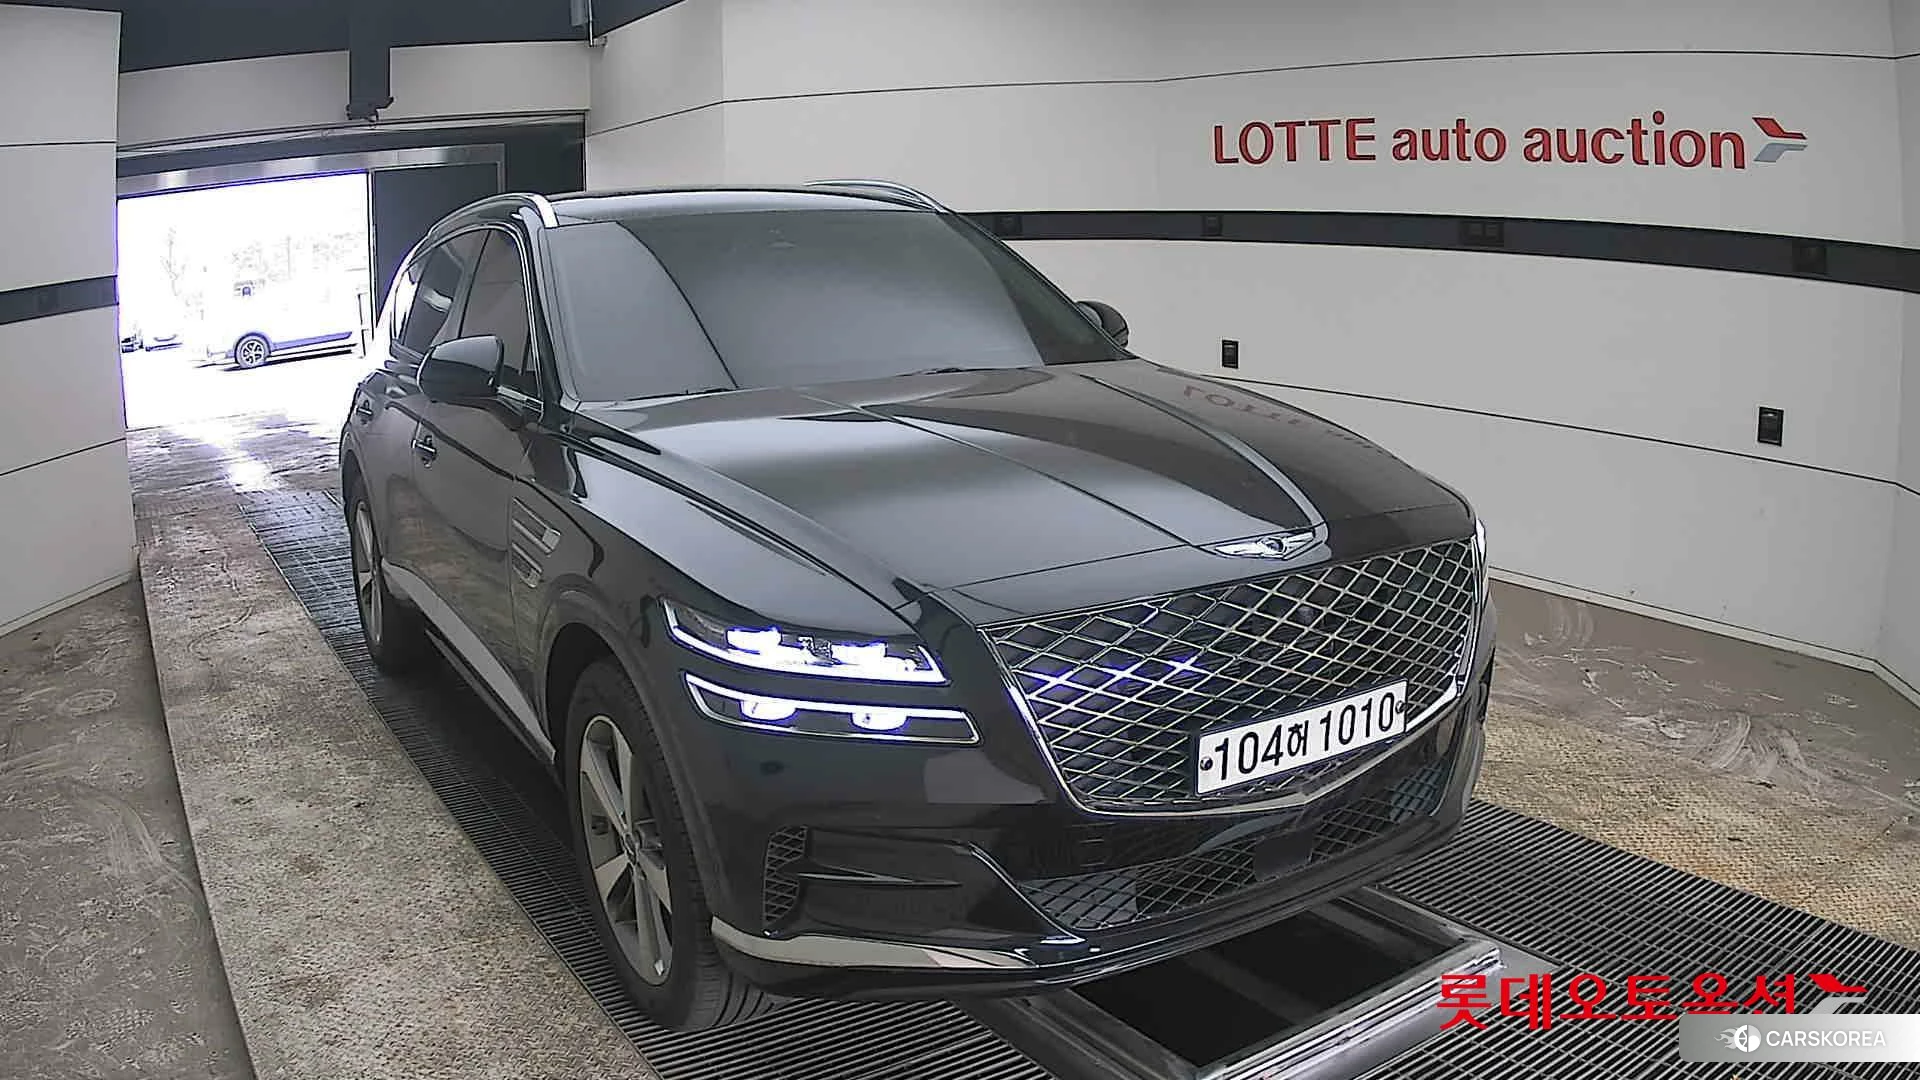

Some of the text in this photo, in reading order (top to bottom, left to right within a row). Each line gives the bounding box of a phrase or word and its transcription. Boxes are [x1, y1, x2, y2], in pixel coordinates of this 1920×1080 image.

[1213, 110, 1747, 169] LOTTE auto auction
[1214, 692, 1394, 781] 104허 1010
